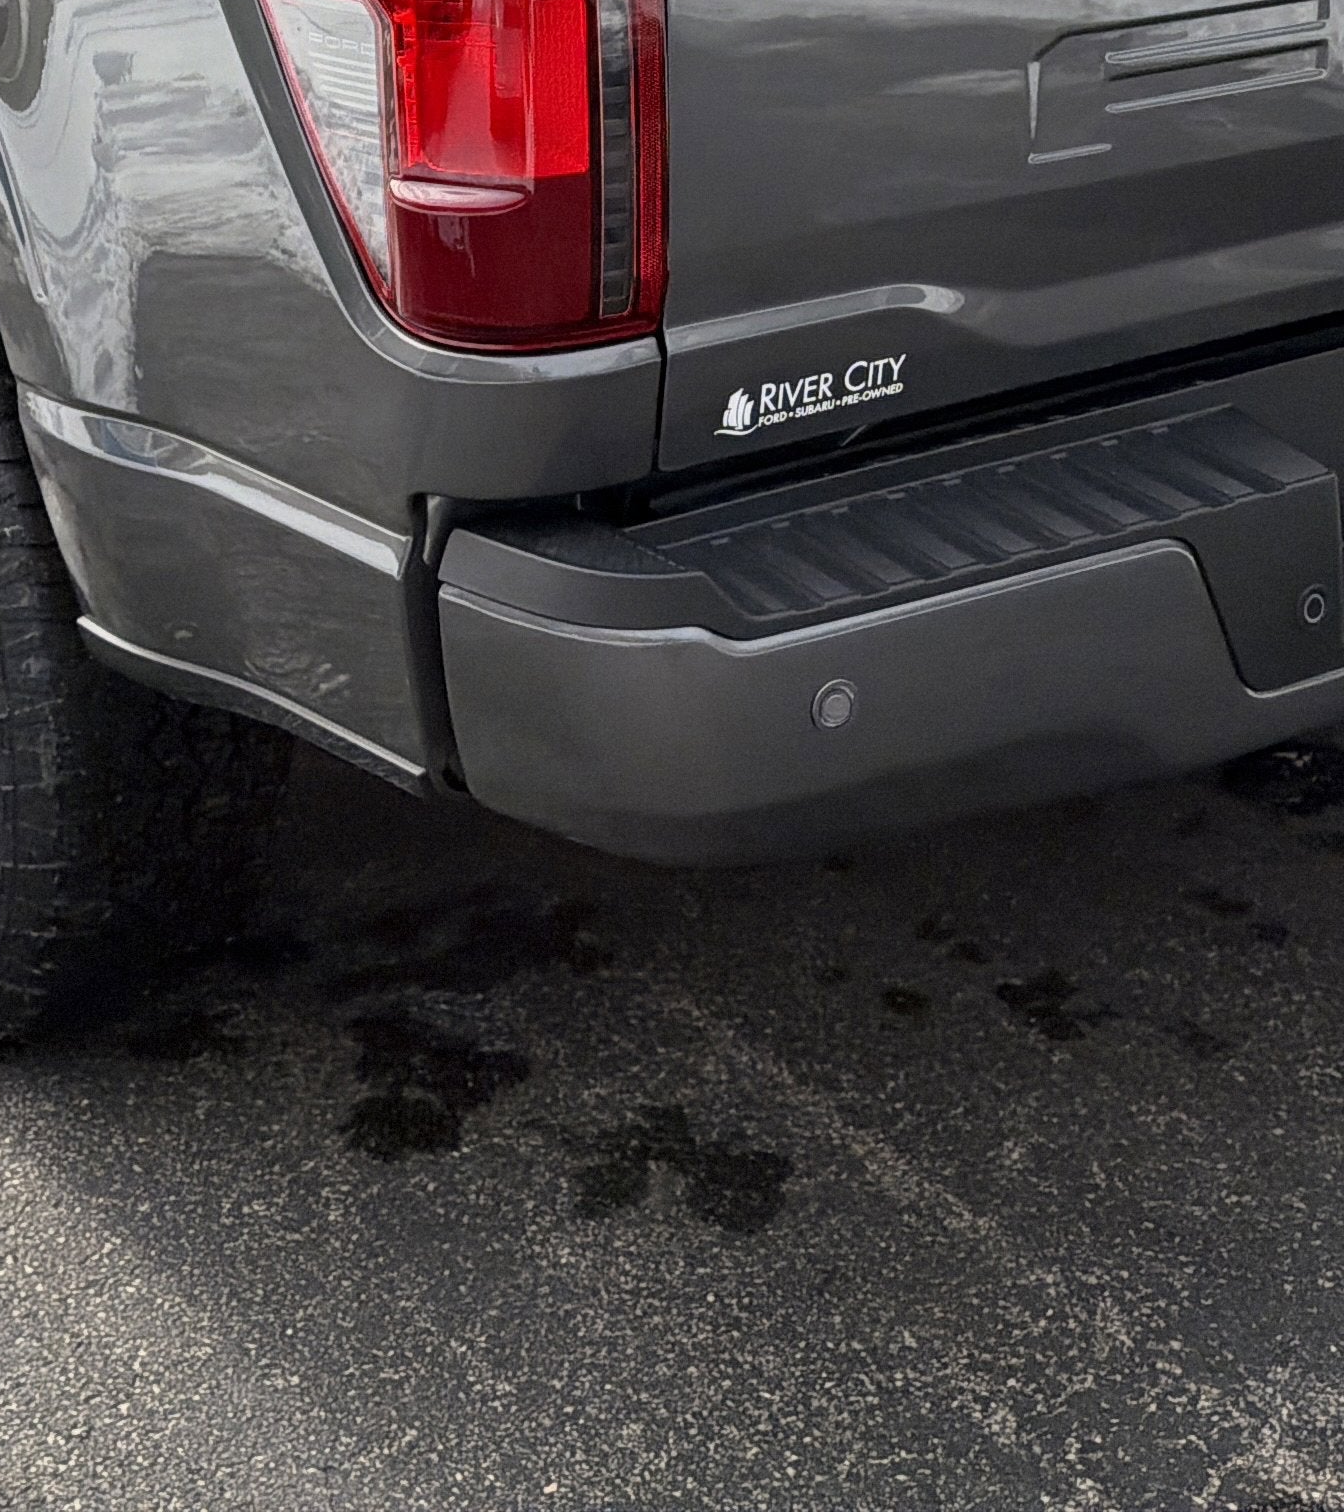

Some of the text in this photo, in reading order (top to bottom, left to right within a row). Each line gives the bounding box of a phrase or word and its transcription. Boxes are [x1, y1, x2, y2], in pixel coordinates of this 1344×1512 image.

[758, 381, 904, 428] FORD SUBARU PRE-OWNED
[759, 353, 907, 414] RIVER CITY
